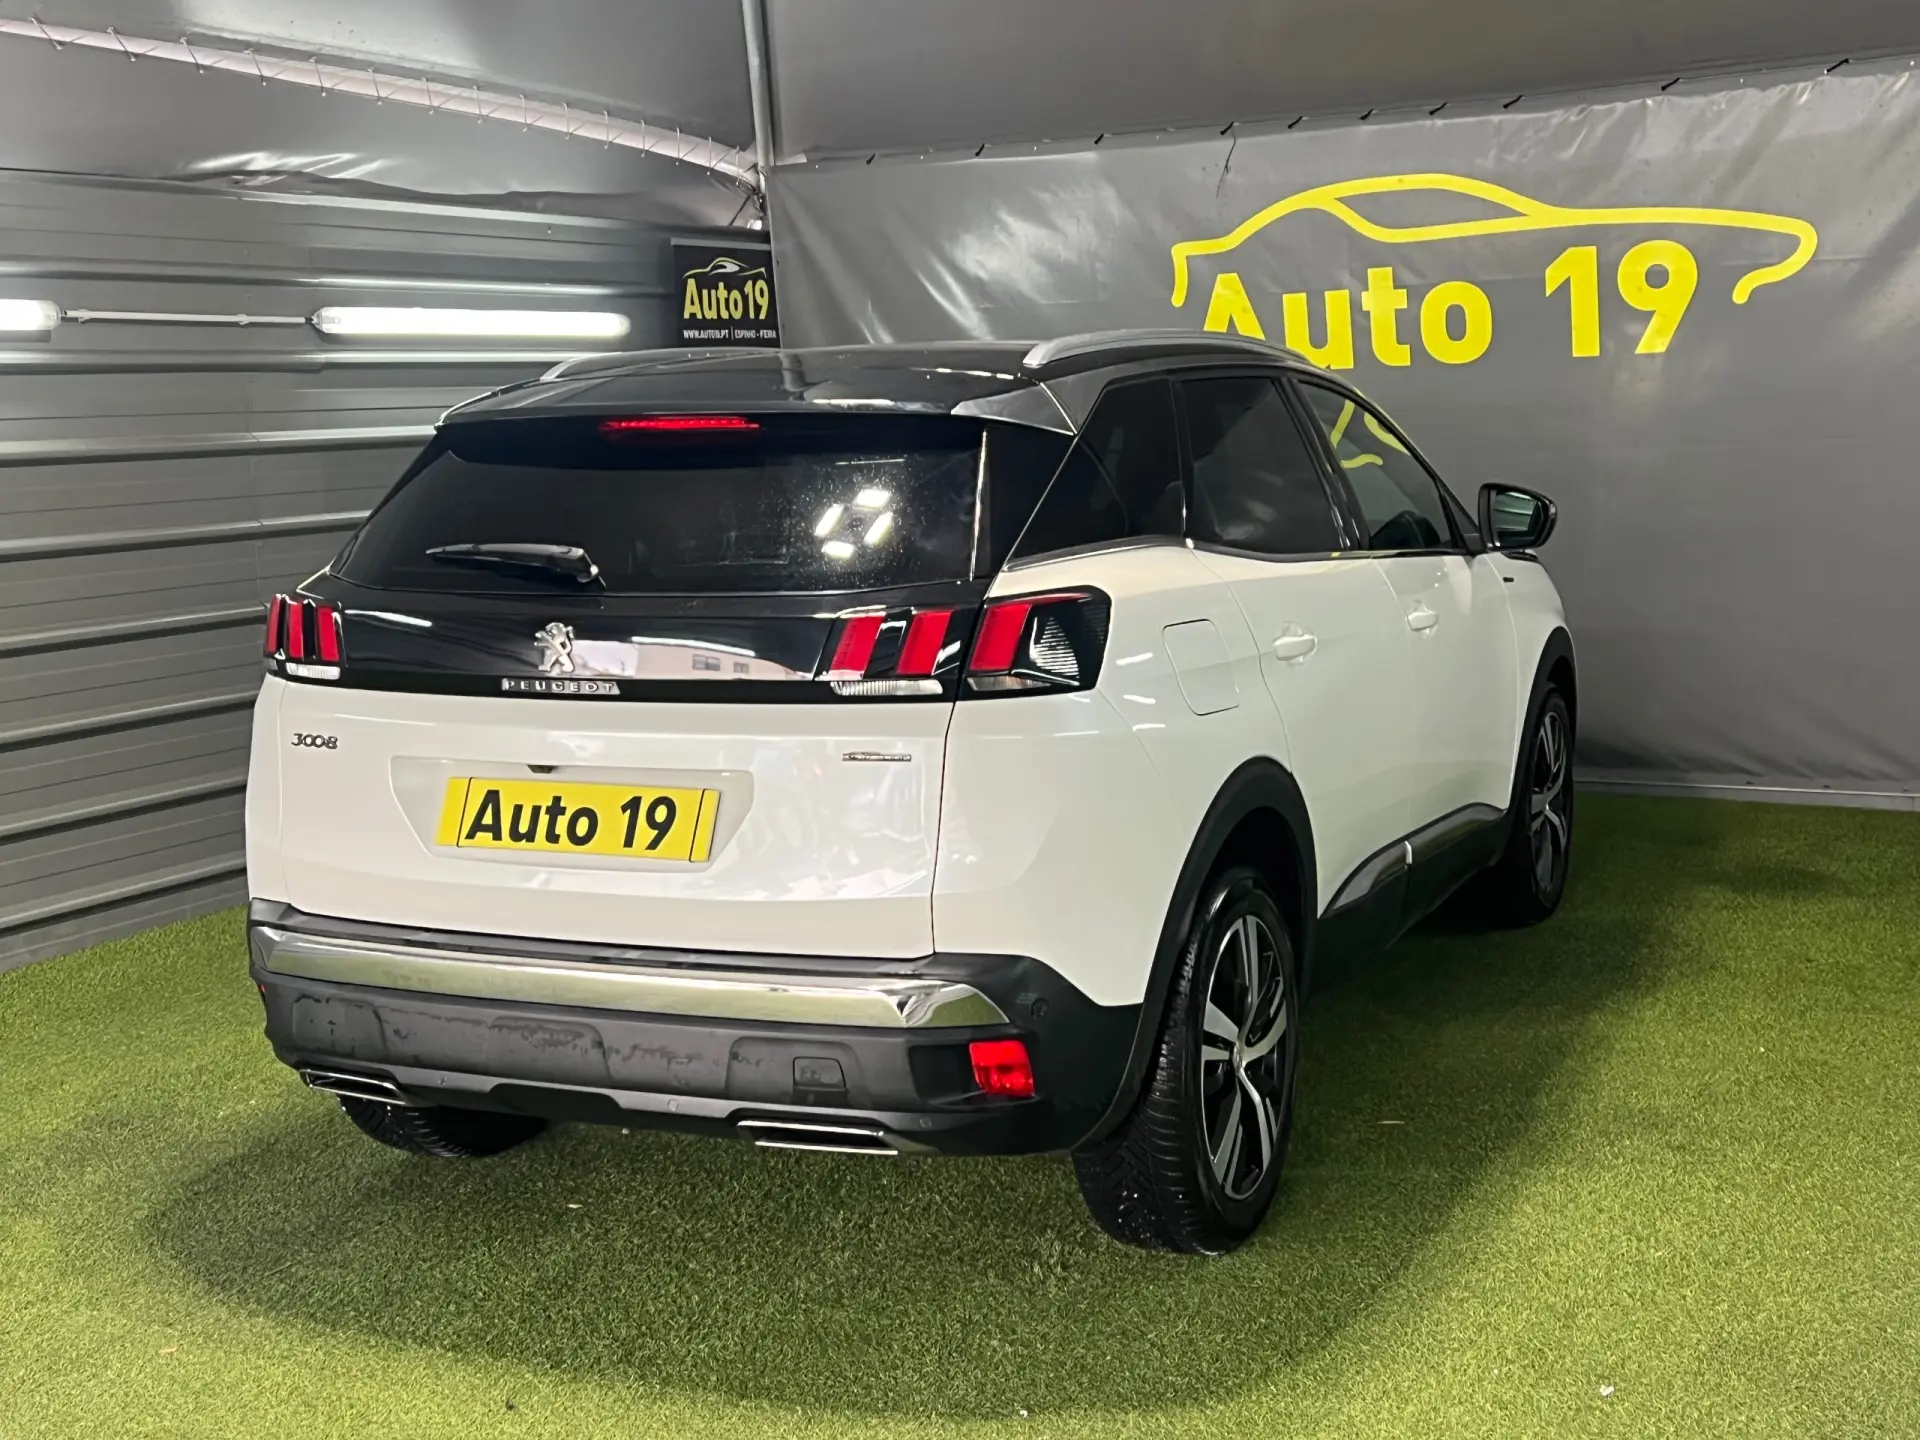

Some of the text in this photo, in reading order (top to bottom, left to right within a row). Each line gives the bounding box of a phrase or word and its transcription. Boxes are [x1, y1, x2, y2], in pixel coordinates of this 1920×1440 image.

[683, 278, 769, 320] Auto 19
[1203, 239, 1698, 370] Auto 19
[502, 677, 615, 694] PEUGEOT
[291, 732, 338, 750] 3008
[464, 789, 677, 851] Auto 19
